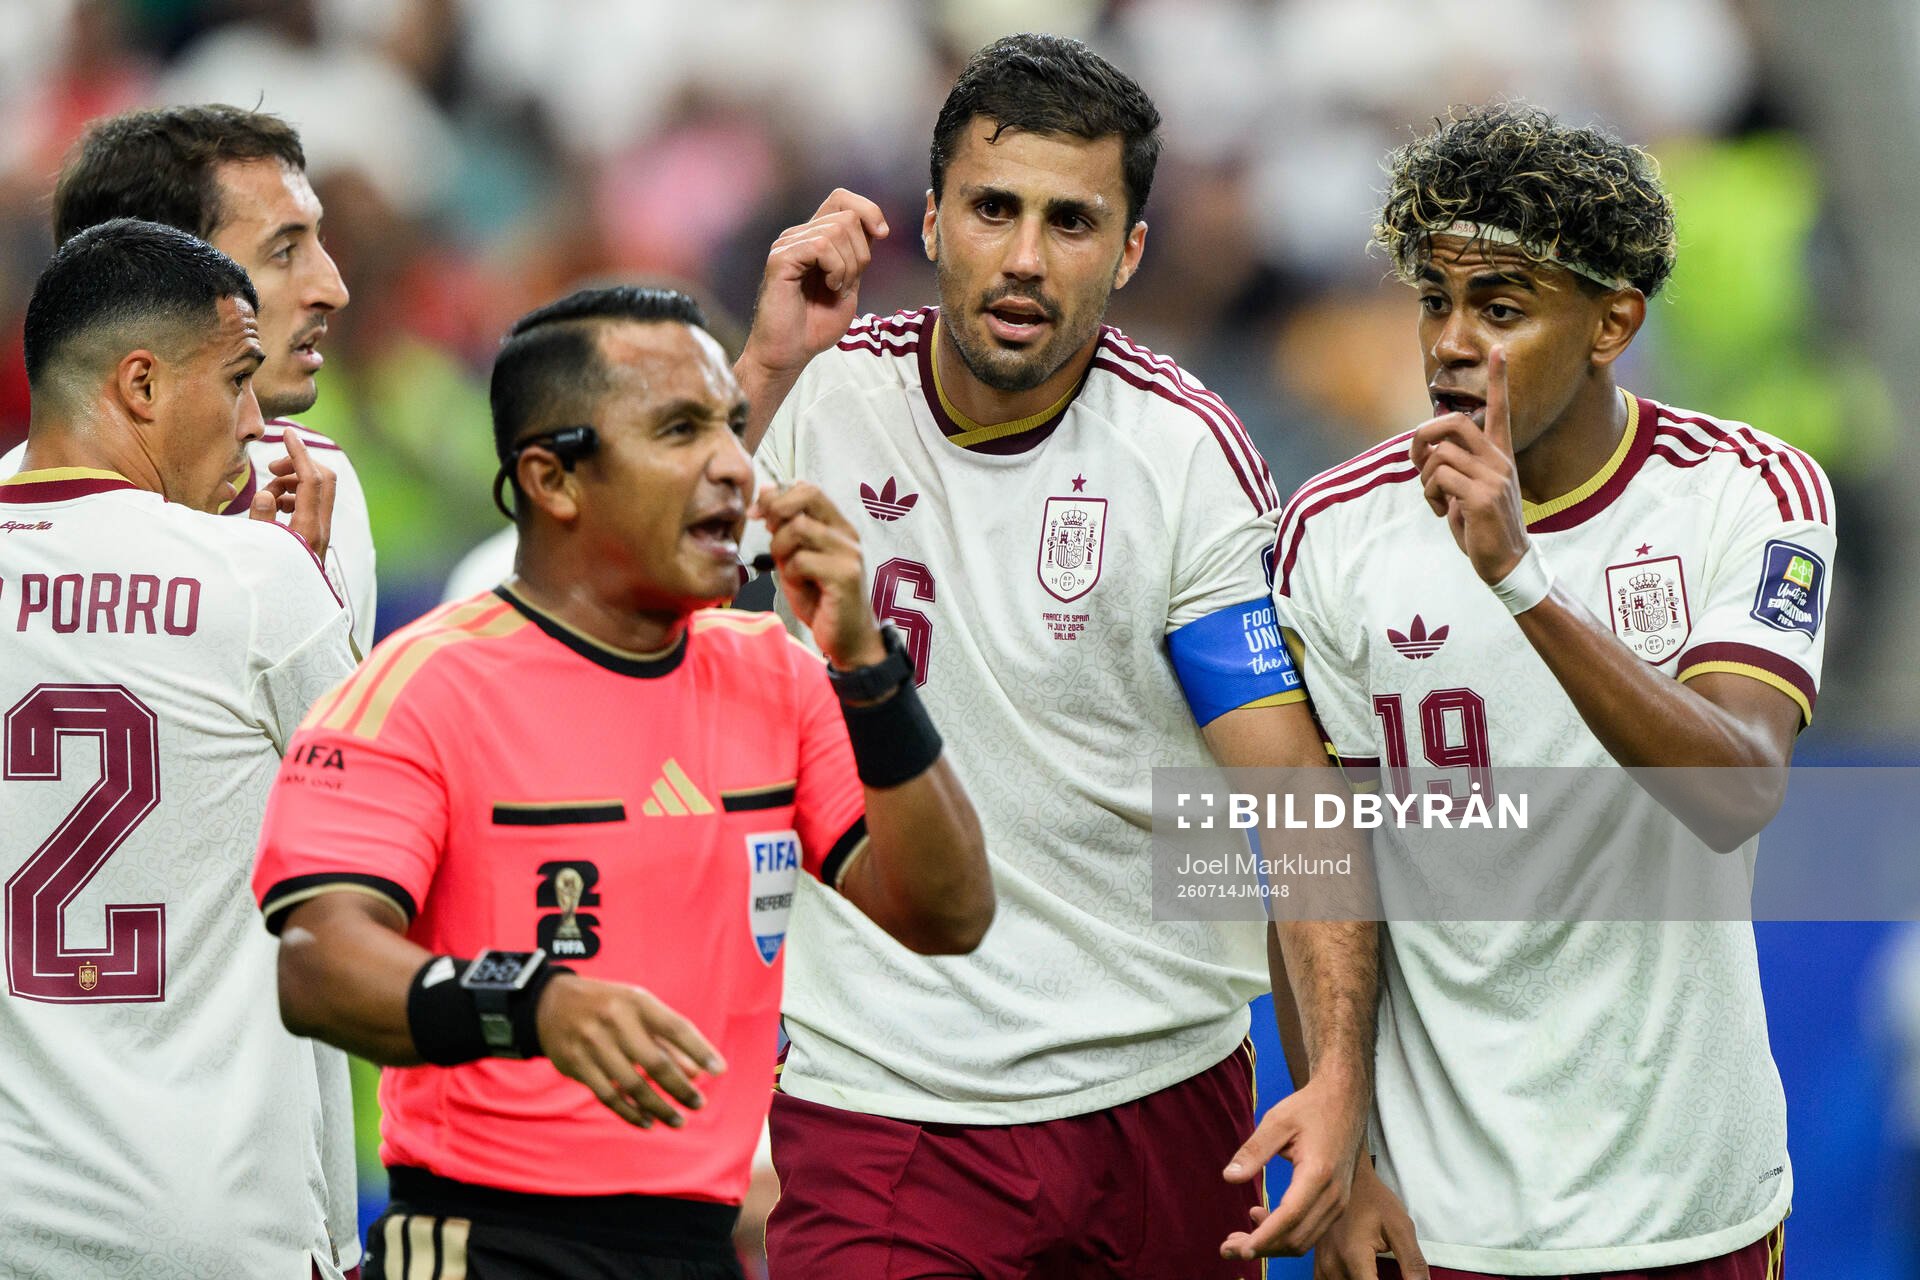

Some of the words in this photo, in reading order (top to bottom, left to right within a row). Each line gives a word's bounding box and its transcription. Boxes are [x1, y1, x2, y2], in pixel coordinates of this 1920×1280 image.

[16, 573, 201, 637] PORRO
[871, 557, 936, 689] 6
[1247, 653, 1282, 675] the
[1372, 687, 1495, 824] 19
[3, 682, 166, 1004] 2
[755, 841, 798, 873] FIFA
[552, 939, 587, 955] FIFA
